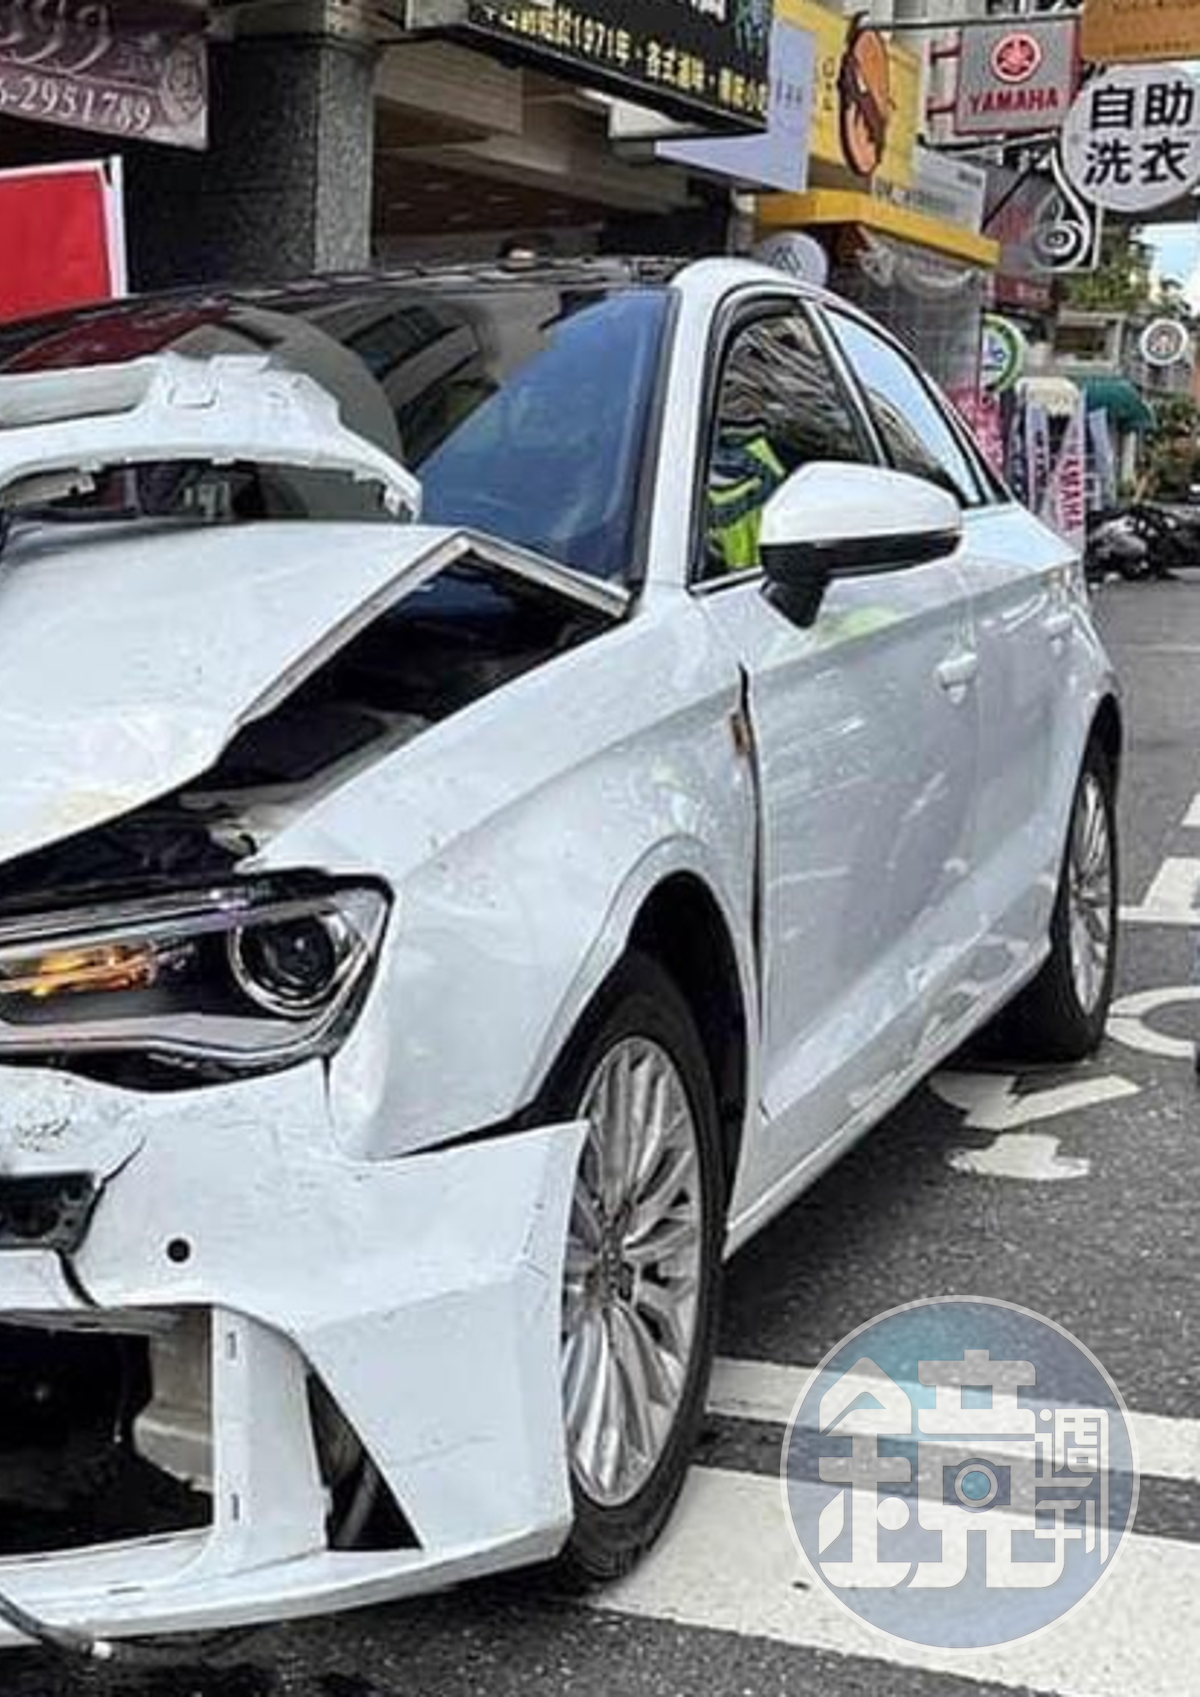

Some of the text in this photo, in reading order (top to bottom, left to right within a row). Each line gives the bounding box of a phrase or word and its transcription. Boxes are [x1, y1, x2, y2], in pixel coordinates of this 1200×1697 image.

[970, 87, 1059, 114] YAMAHA
[1090, 81, 1195, 130] 自助
[1084, 137, 1191, 186] 洗衣
